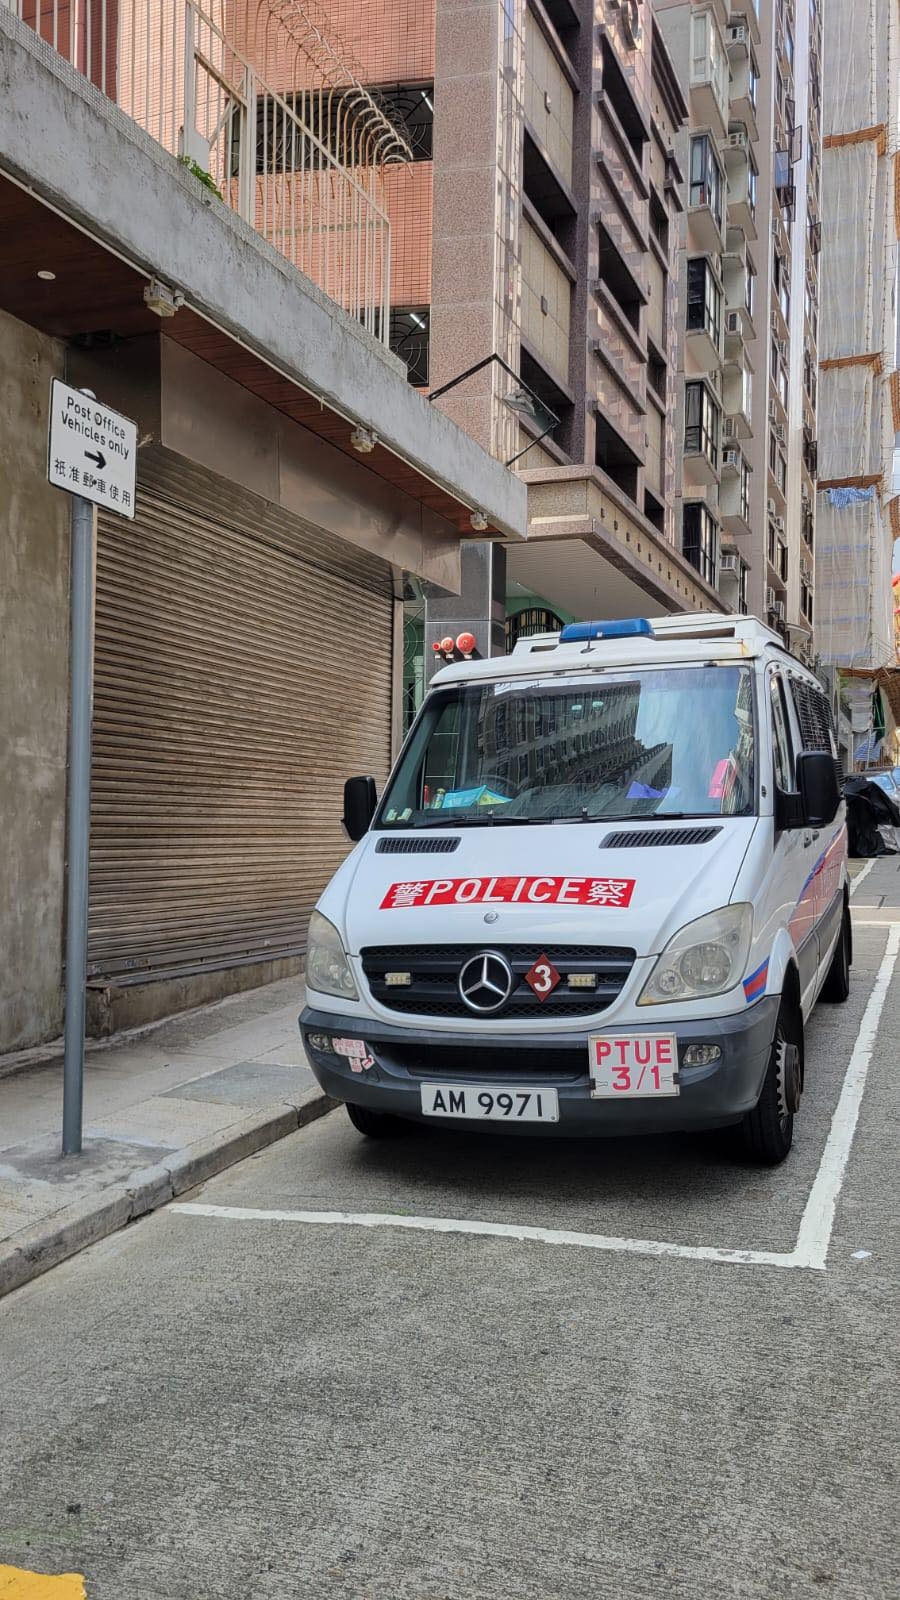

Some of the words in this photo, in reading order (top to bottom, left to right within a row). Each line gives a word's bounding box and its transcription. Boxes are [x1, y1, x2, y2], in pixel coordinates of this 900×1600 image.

[67, 396, 92, 421] Post
[94, 412, 126, 440] Office
[61, 410, 106, 446] Vehicles
[108, 439, 129, 460] only
[534, 965, 552, 992] 3
[596, 1039, 672, 1066] PTUE
[611, 1065, 660, 1090] 3/1
[432, 1090, 466, 1114] AM
[477, 1092, 543, 1117] 9971
